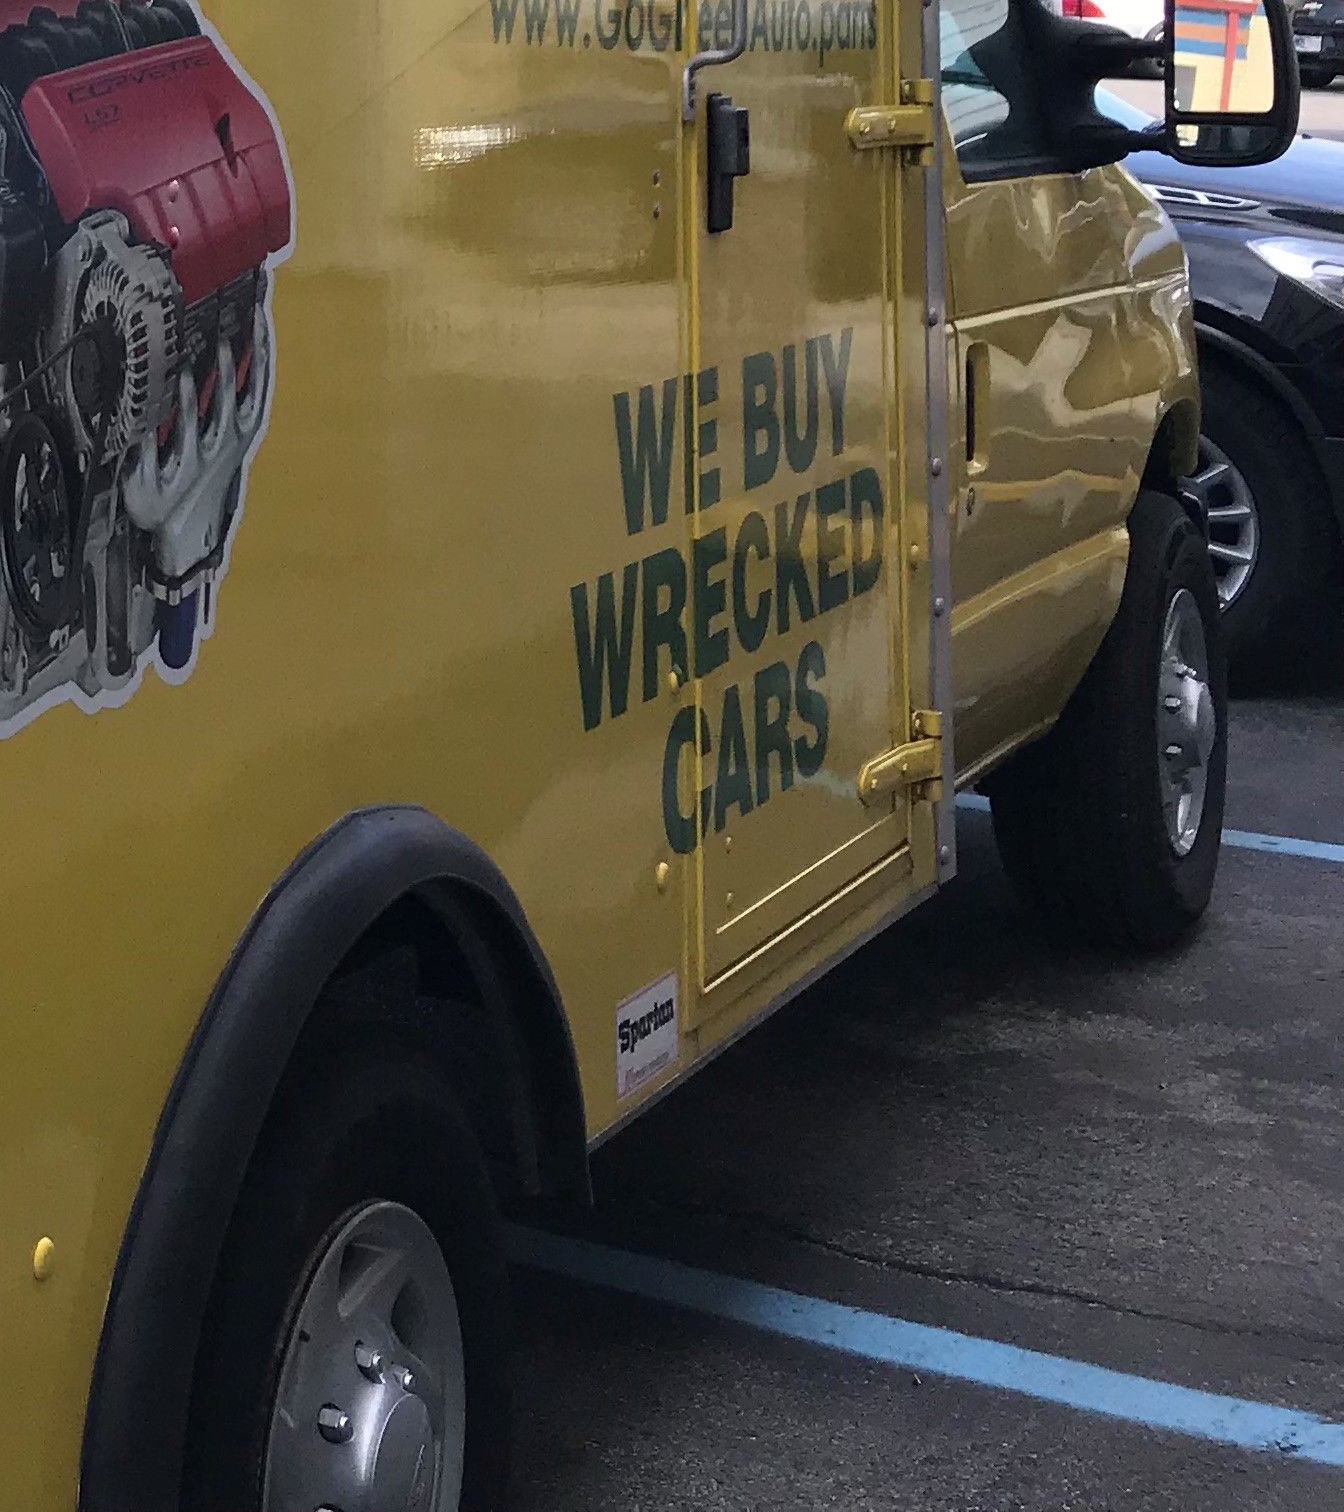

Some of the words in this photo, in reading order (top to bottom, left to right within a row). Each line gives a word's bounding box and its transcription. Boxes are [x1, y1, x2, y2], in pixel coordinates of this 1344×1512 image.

[613, 366, 721, 536] WE
[742, 327, 853, 493] BUY
[570, 466, 884, 734] WRECKED
[662, 641, 829, 855] CARS
[618, 997, 674, 1054] Spartan
